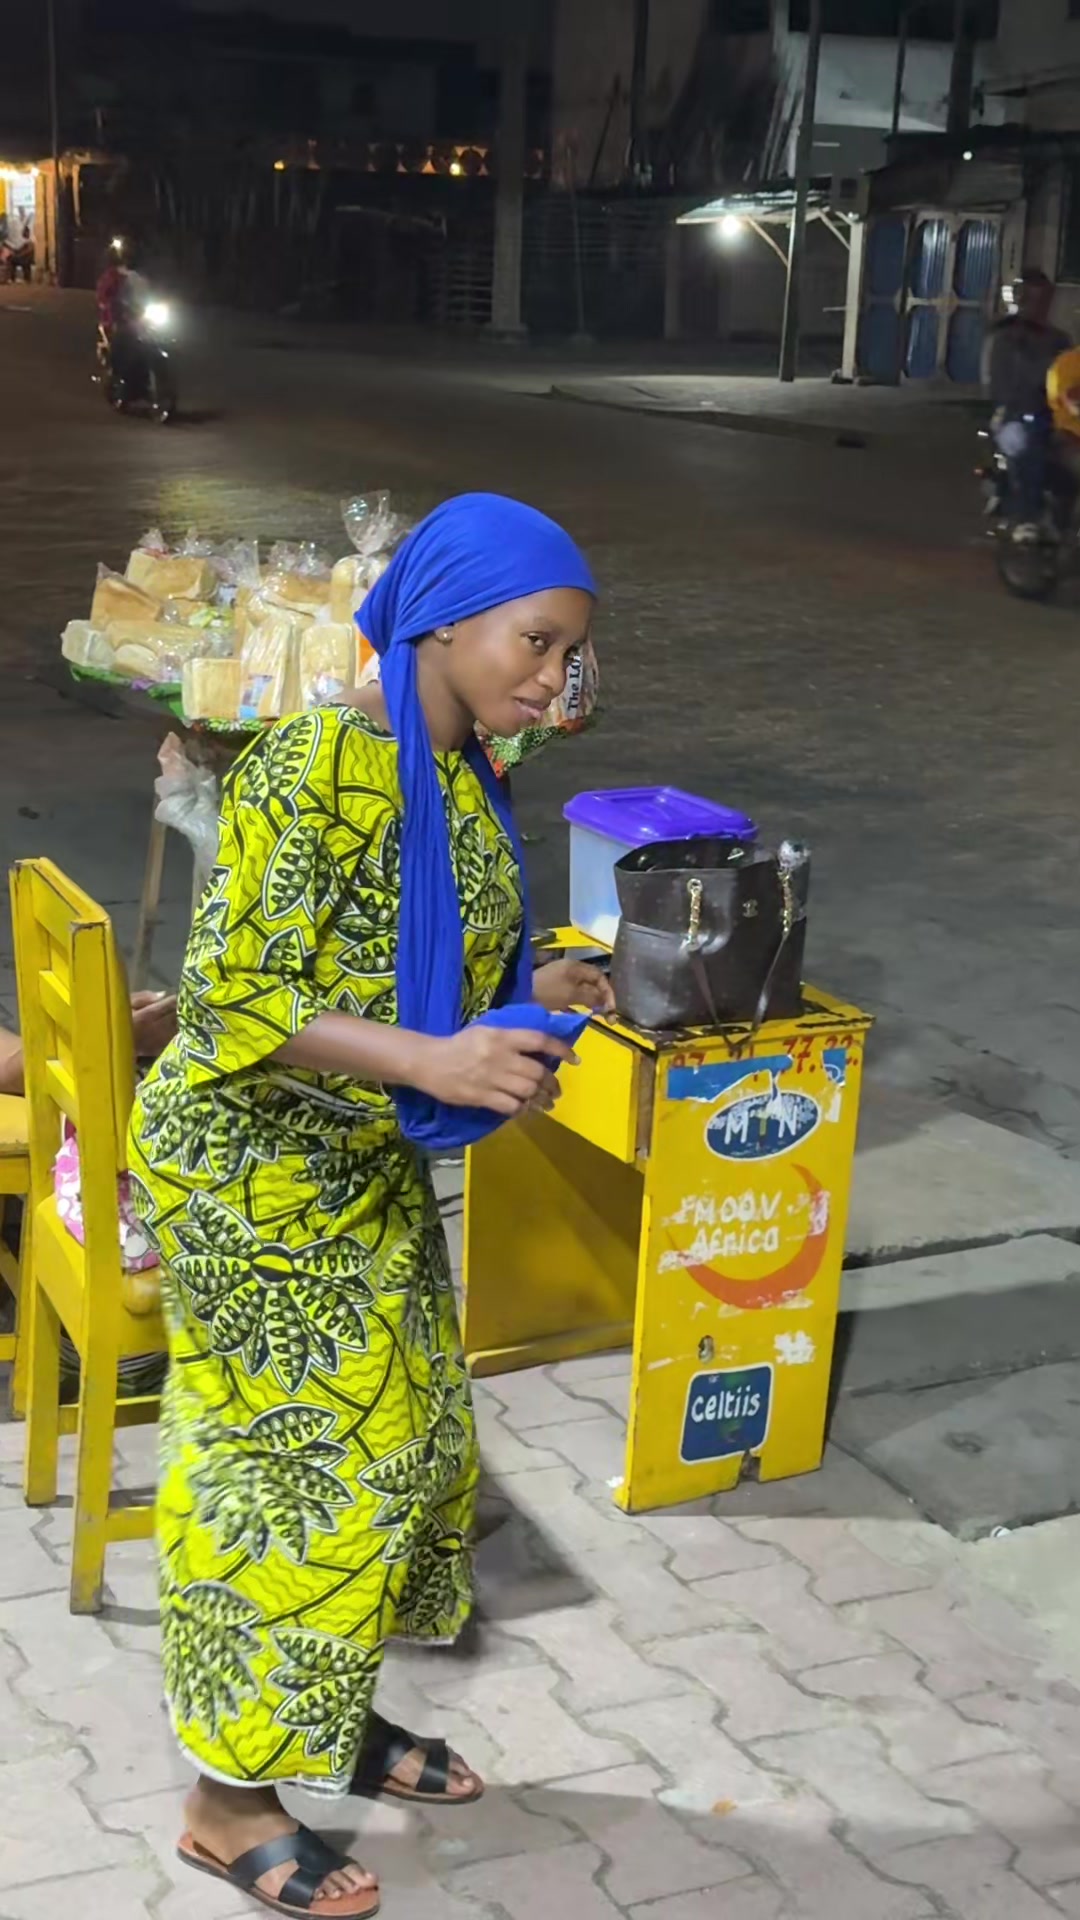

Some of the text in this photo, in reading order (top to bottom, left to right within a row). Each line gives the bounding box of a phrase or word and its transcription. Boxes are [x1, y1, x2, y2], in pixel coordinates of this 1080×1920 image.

[567, 684, 580, 711] The
[724, 1105, 798, 1145] MTN
[691, 1385, 760, 1423] celtiis
